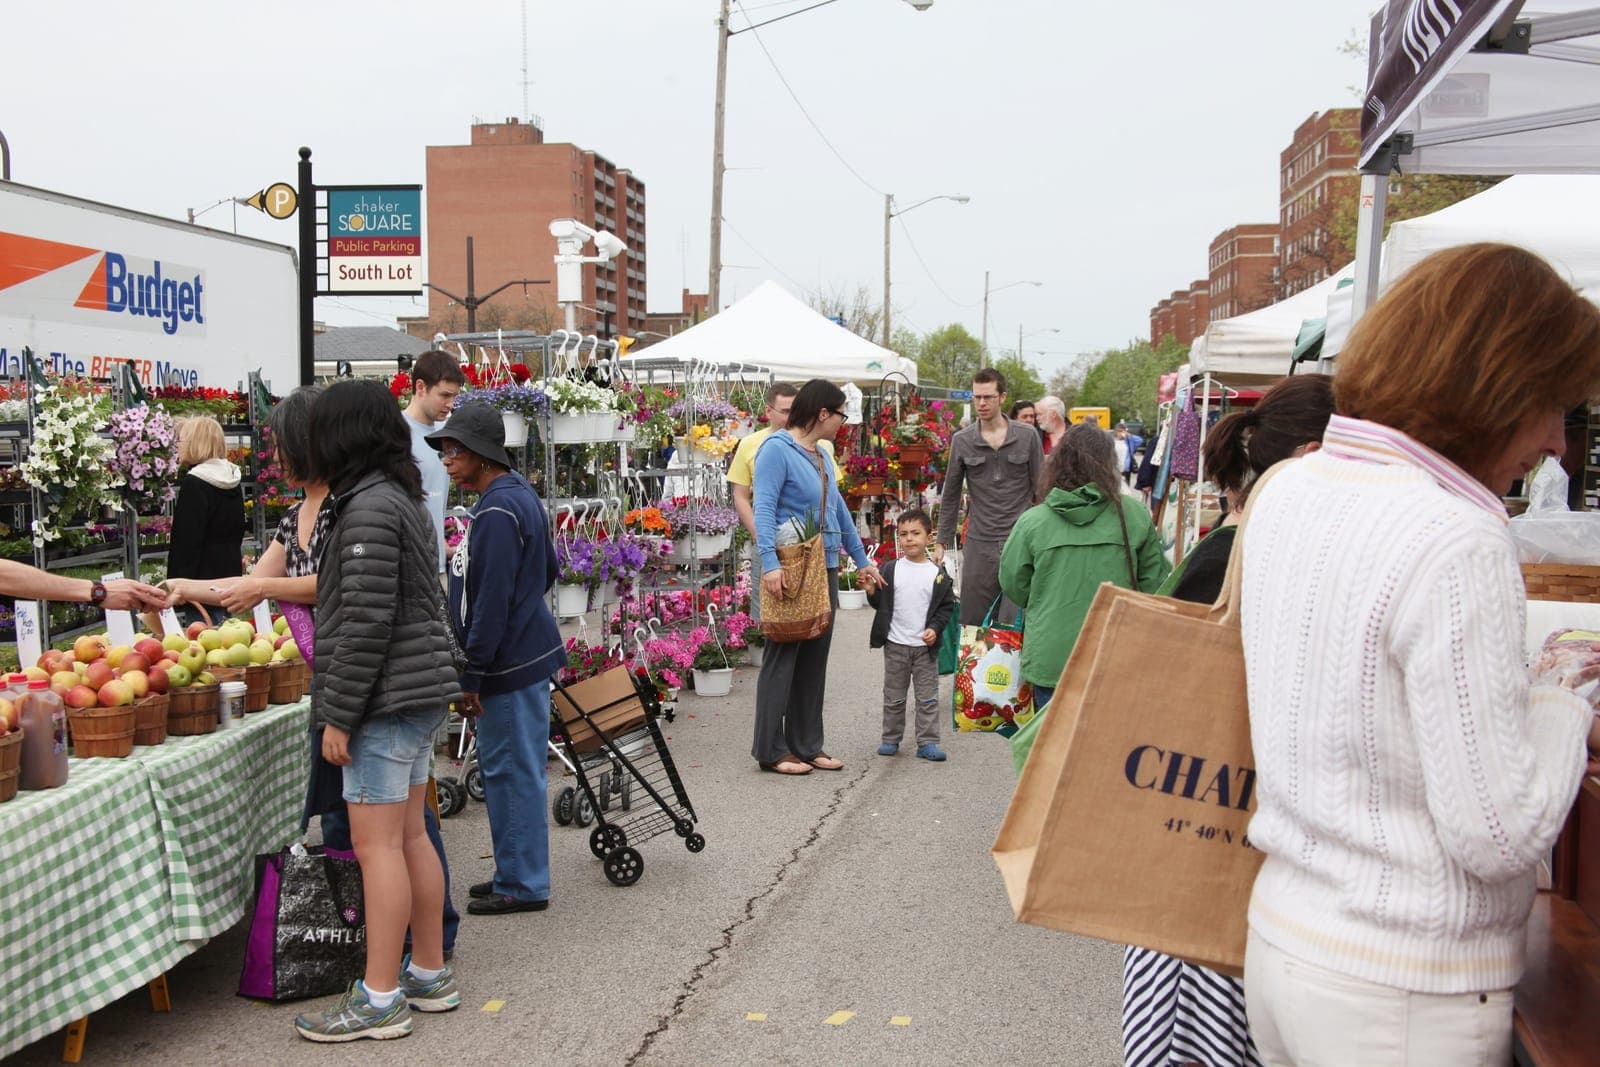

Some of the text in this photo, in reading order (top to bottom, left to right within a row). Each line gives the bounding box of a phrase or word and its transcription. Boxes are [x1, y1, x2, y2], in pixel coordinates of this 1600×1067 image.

[274, 189, 290, 214] P
[354, 194, 400, 213] shaker
[336, 240, 415, 255] Public Parking
[338, 263, 413, 280] South Lot
[105, 251, 204, 335] Budget
[50, 352, 85, 378] The
[1124, 744, 1257, 812] CHAT
